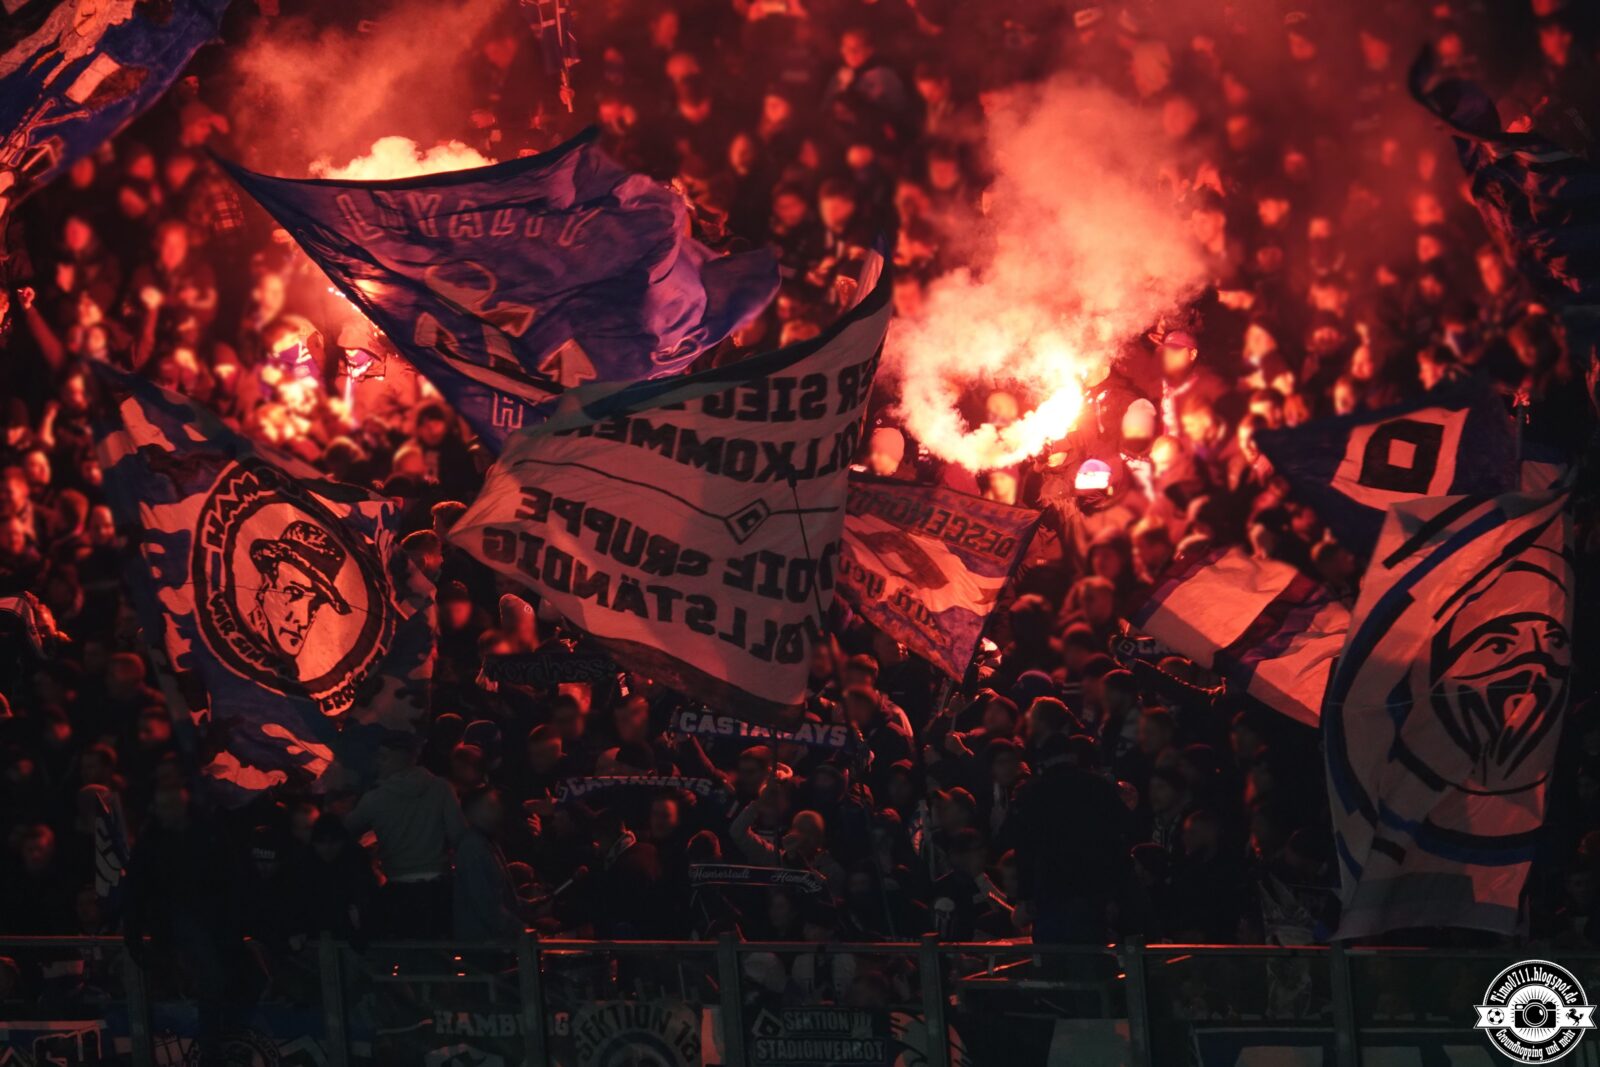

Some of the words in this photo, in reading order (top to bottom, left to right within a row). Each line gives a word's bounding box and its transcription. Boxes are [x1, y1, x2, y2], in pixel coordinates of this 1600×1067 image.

[435, 1008, 570, 1037] HAMBG
[783, 1010, 850, 1032] SEKTION
[756, 1039, 884, 1062] STADIONVERBOT
